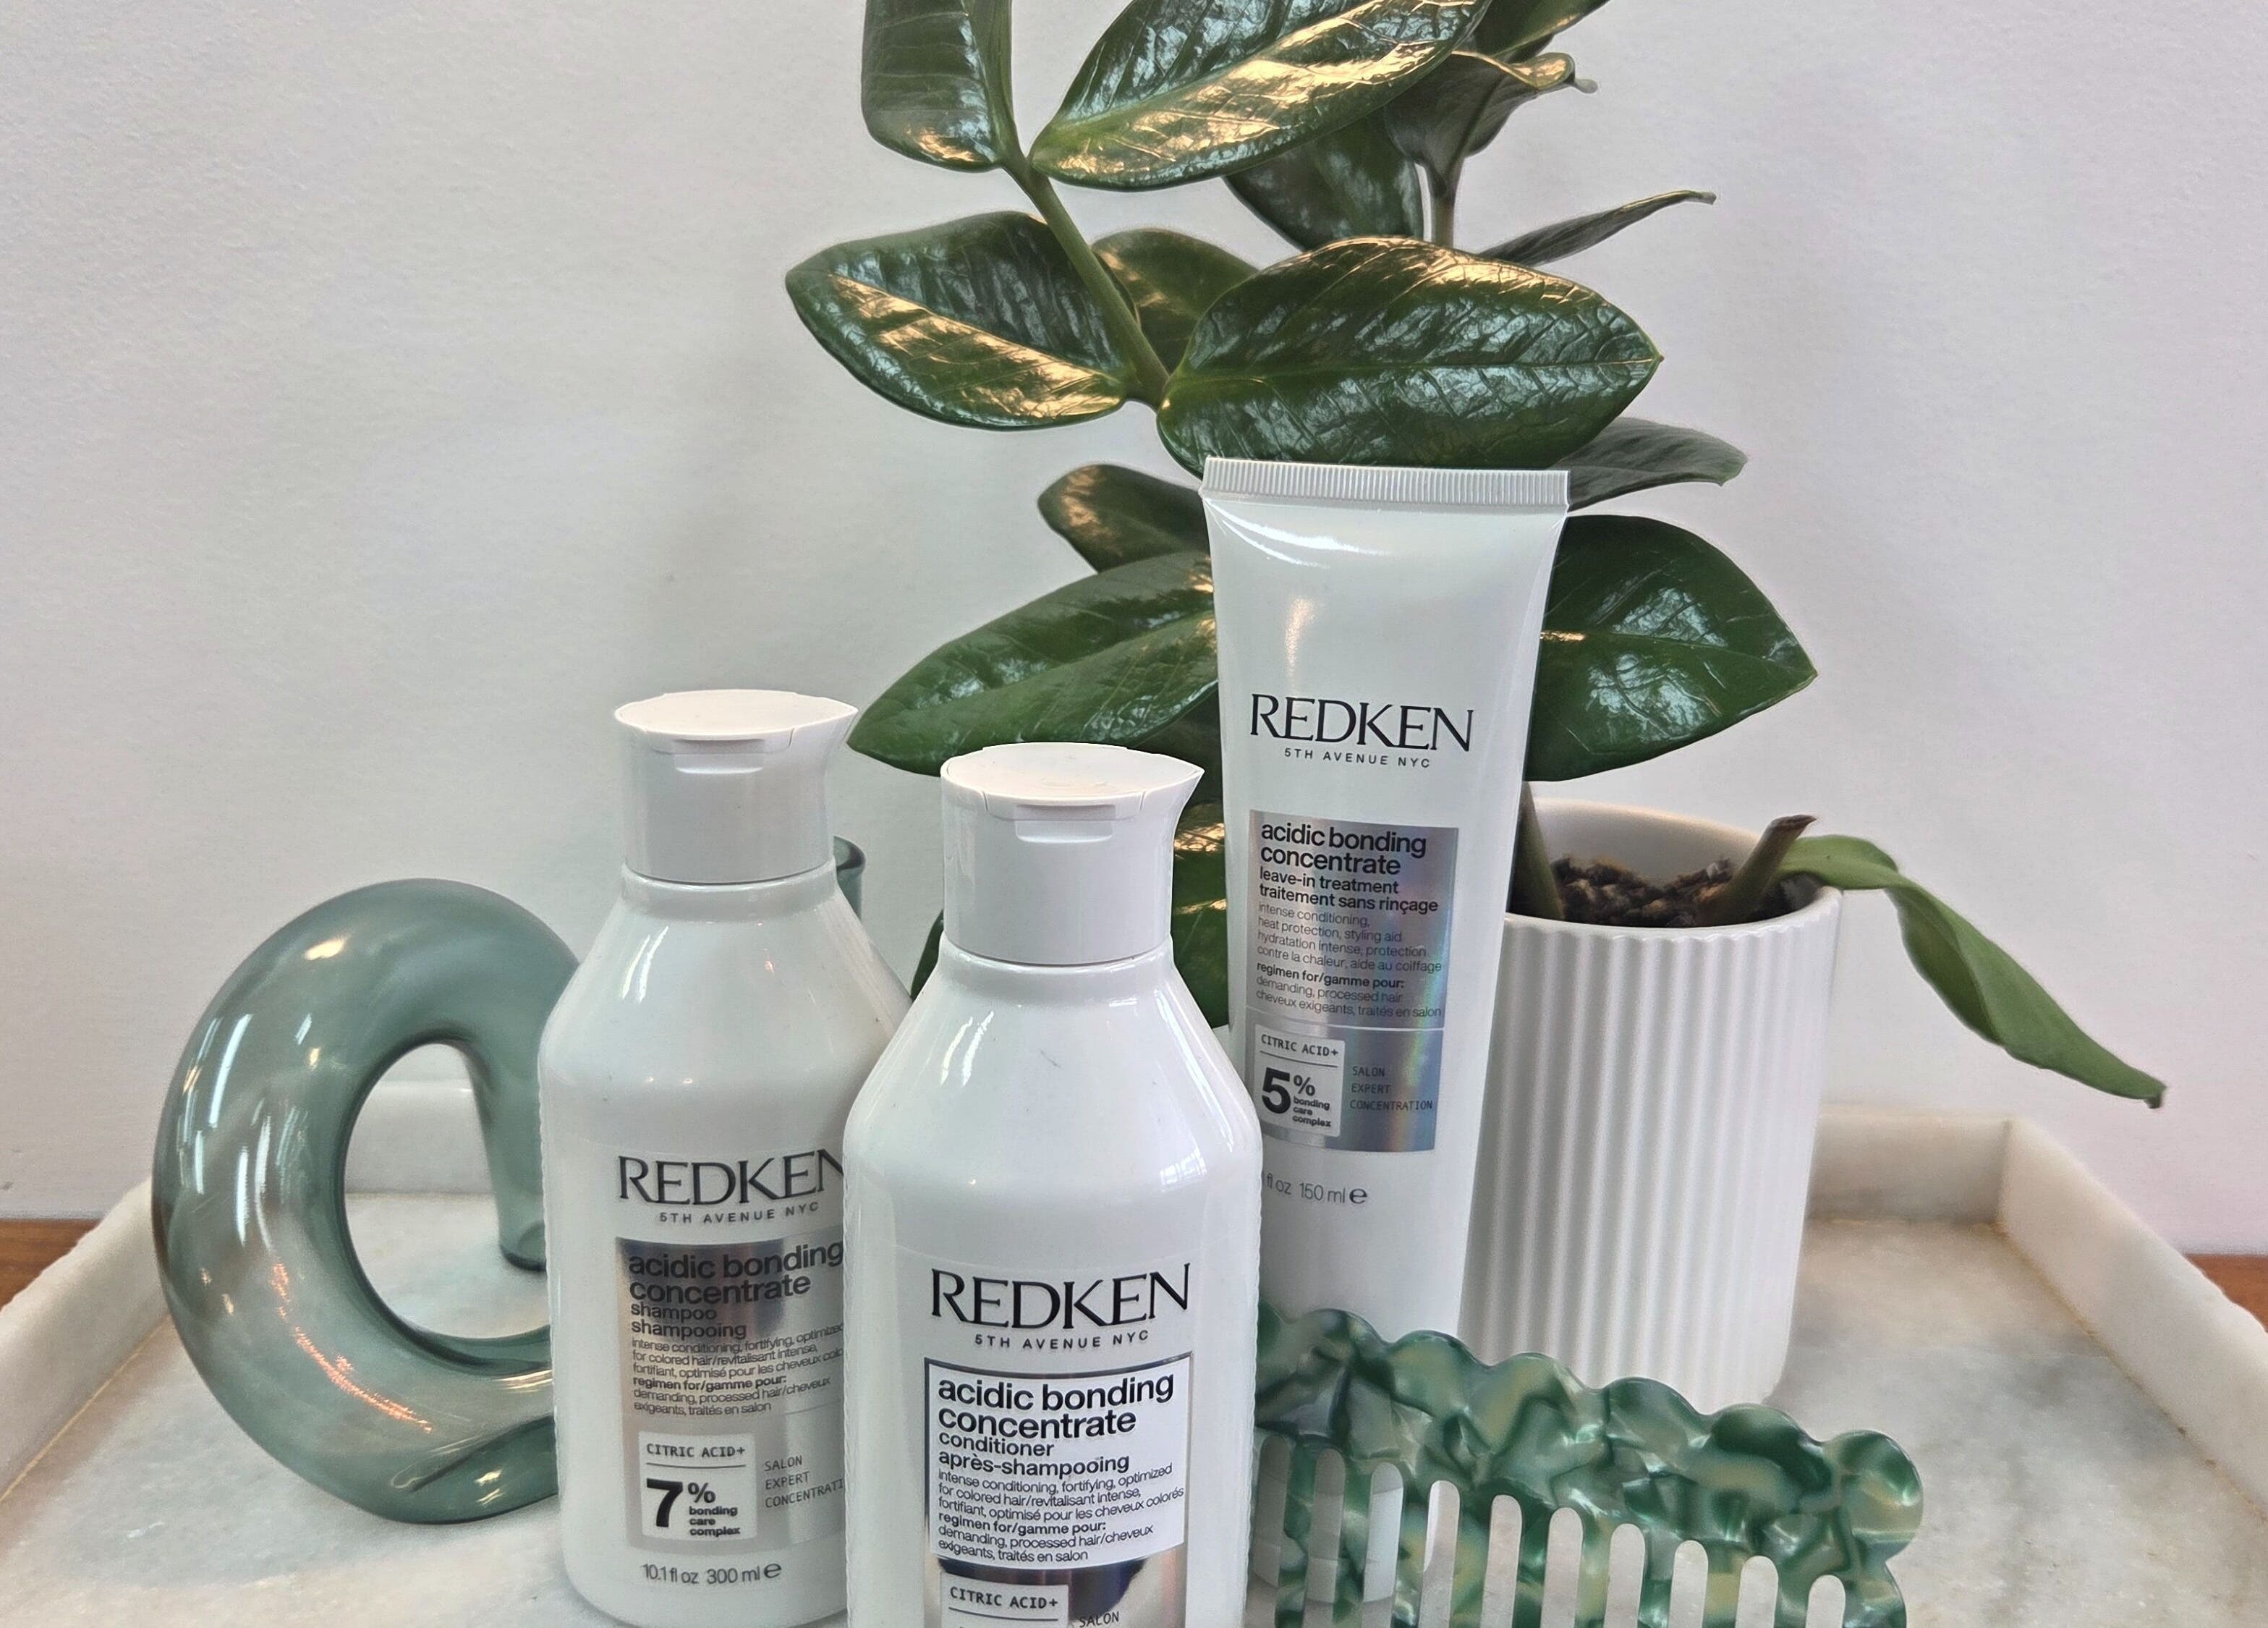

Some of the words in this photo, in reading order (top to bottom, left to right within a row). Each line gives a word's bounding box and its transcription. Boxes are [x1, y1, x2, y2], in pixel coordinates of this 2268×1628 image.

[1250, 694, 1474, 751] REDKEN
[1285, 747, 1313, 759] 5TH
[1323, 752, 1388, 765] AVENUE
[1398, 757, 1430, 768] NYC
[1262, 823, 1325, 846] acidic
[1329, 827, 1426, 858] bonding
[1260, 847, 1400, 875] concentrate
[1260, 866, 1315, 888] leave-in
[1320, 876, 1398, 893] treatment
[1260, 883, 1335, 906] traitement
[1339, 896, 1375, 910] sans
[1379, 899, 1438, 914] rinçage
[1259, 902, 1294, 917] intense
[1297, 910, 1369, 927] conditioning,
[1258, 917, 1279, 930] heat
[1282, 923, 1341, 939] protection,
[1344, 930, 1381, 944] styling
[1385, 932, 1401, 941] aid
[1258, 930, 1315, 950] hydratation
[1319, 941, 1363, 956] intense,
[1366, 945, 1426, 957] protection
[1257, 946, 1288, 960] contre
[1291, 951, 1300, 962] la
[1303, 954, 1347, 969] chaleur,
[1350, 959, 1375, 970] aide
[1396, 961, 1442, 973] coiffage
[1257, 962, 1299, 979] regimen
[1302, 970, 1369, 987] for/gamme
[1373, 979, 1403, 988] pour:
[1257, 977, 1314, 998] demanding,
[1318, 989, 1378, 1001] processed
[1382, 993, 1401, 1002] hair
[1257, 990, 1296, 1007] cheveux
[1299, 1000, 1355, 1016] exigeants,
[1359, 1006, 1393, 1016] traités
[1413, 1007, 1441, 1017] salon
[1261, 1034, 1296, 1051] CITRIC
[1302, 1043, 1338, 1056] ACID+
[1352, 1067, 1385, 1077] SALON
[1351, 1083, 1390, 1094] EXPERT
[1293, 1106, 1312, 1116] care
[1294, 1096, 1330, 1111] bonding
[1349, 1100, 1432, 1111] CONCENTRATION
[1292, 1116, 1331, 1127] complex
[1276, 1179, 1291, 1195] oz
[1299, 1182, 1323, 1200] 150
[1328, 1187, 1345, 1203] ml
[661, 1213, 692, 1224] 5TH
[703, 1210, 775, 1223] AVENUE
[786, 1203, 819, 1216] NYC
[629, 1254, 715, 1279] acidic
[724, 1242, 844, 1277] bonding
[629, 1275, 811, 1304] concentrate
[932, 1263, 1190, 1329] REDKEN
[631, 1303, 717, 1323] shampoo
[632, 1319, 747, 1340] shampooing
[975, 1334, 1010, 1349] 5TH
[1023, 1336, 1101, 1349] AVENUE
[1113, 1330, 1148, 1344] NYC
[632, 1339, 669, 1351] intense
[672, 1343, 742, 1354] conditioning,
[746, 1336, 794, 1350] fortifying,
[633, 1349, 646, 1360] for
[649, 1354, 689, 1365] colored
[692, 1351, 776, 1365] hair/revitalisant
[778, 1344, 817, 1358] intense,
[634, 1362, 676, 1378] fortifiant,
[679, 1368, 726, 1379] optimisé
[729, 1368, 755, 1379] pour
[758, 1365, 773, 1374] les
[776, 1354, 821, 1372] cheveux
[823, 1348, 844, 1361] colo
[633, 1377, 681, 1389] regimen
[684, 1381, 752, 1392] for/gamme
[755, 1376, 786, 1388] pour:
[634, 1389, 697, 1404] demanding,
[700, 1390, 759, 1404] processed
[763, 1377, 831, 1396] hair/cheveux
[939, 1378, 1033, 1410] acidic
[1042, 1374, 1173, 1411] bonding
[634, 1402, 686, 1416] exigeants,
[689, 1406, 722, 1415] traités
[742, 1402, 771, 1413] salon
[939, 1409, 1136, 1438] concentrate
[647, 1443, 695, 1457] CITRIC
[702, 1446, 744, 1457] ACID+
[939, 1433, 1054, 1457] conditioner
[765, 1456, 802, 1471] SALON
[938, 1451, 1129, 1479] après-shampooing
[765, 1472, 810, 1489] EXPERT
[939, 1469, 979, 1488] intense
[982, 1480, 1058, 1495] conditioning,
[1062, 1479, 1115, 1493] fortifying,
[1118, 1462, 1172, 1487] optimized
[765, 1478, 843, 1508] CONCENTRATI
[938, 1483, 954, 1496] for
[956, 1489, 1001, 1504] colored
[1004, 1492, 1095, 1506] hair/revitalisant
[1097, 1488, 1141, 1503] intense,
[689, 1506, 738, 1517] bonding
[939, 1496, 986, 1518] fortifiant,
[989, 1509, 1040, 1521] optimisé
[1044, 1511, 1073, 1523] pour
[1076, 1509, 1092, 1519] les
[1095, 1501, 1144, 1517] cheveux
[1146, 1487, 1184, 1507] colorés
[689, 1527, 740, 1537] complex
[939, 1512, 990, 1527] regimen
[993, 1522, 1069, 1535] for/gamme
[1072, 1522, 1105, 1535] pour:
[939, 1525, 1007, 1548] demanding,
[1010, 1536, 1076, 1549] processed
[1079, 1525, 1153, 1546] hair/cheveux
[938, 1539, 995, 1560] exigeants,
[998, 1549, 1035, 1561] traités
[1056, 1551, 1088, 1561] salon
[681, 1571, 698, 1584] oz
[707, 1568, 737, 1584] 300
[742, 1566, 760, 1582] ml
[950, 1587, 1002, 1606] CITRIC
[1010, 1598, 1058, 1608] ACID+
[1079, 1611, 1119, 1627] SALON
